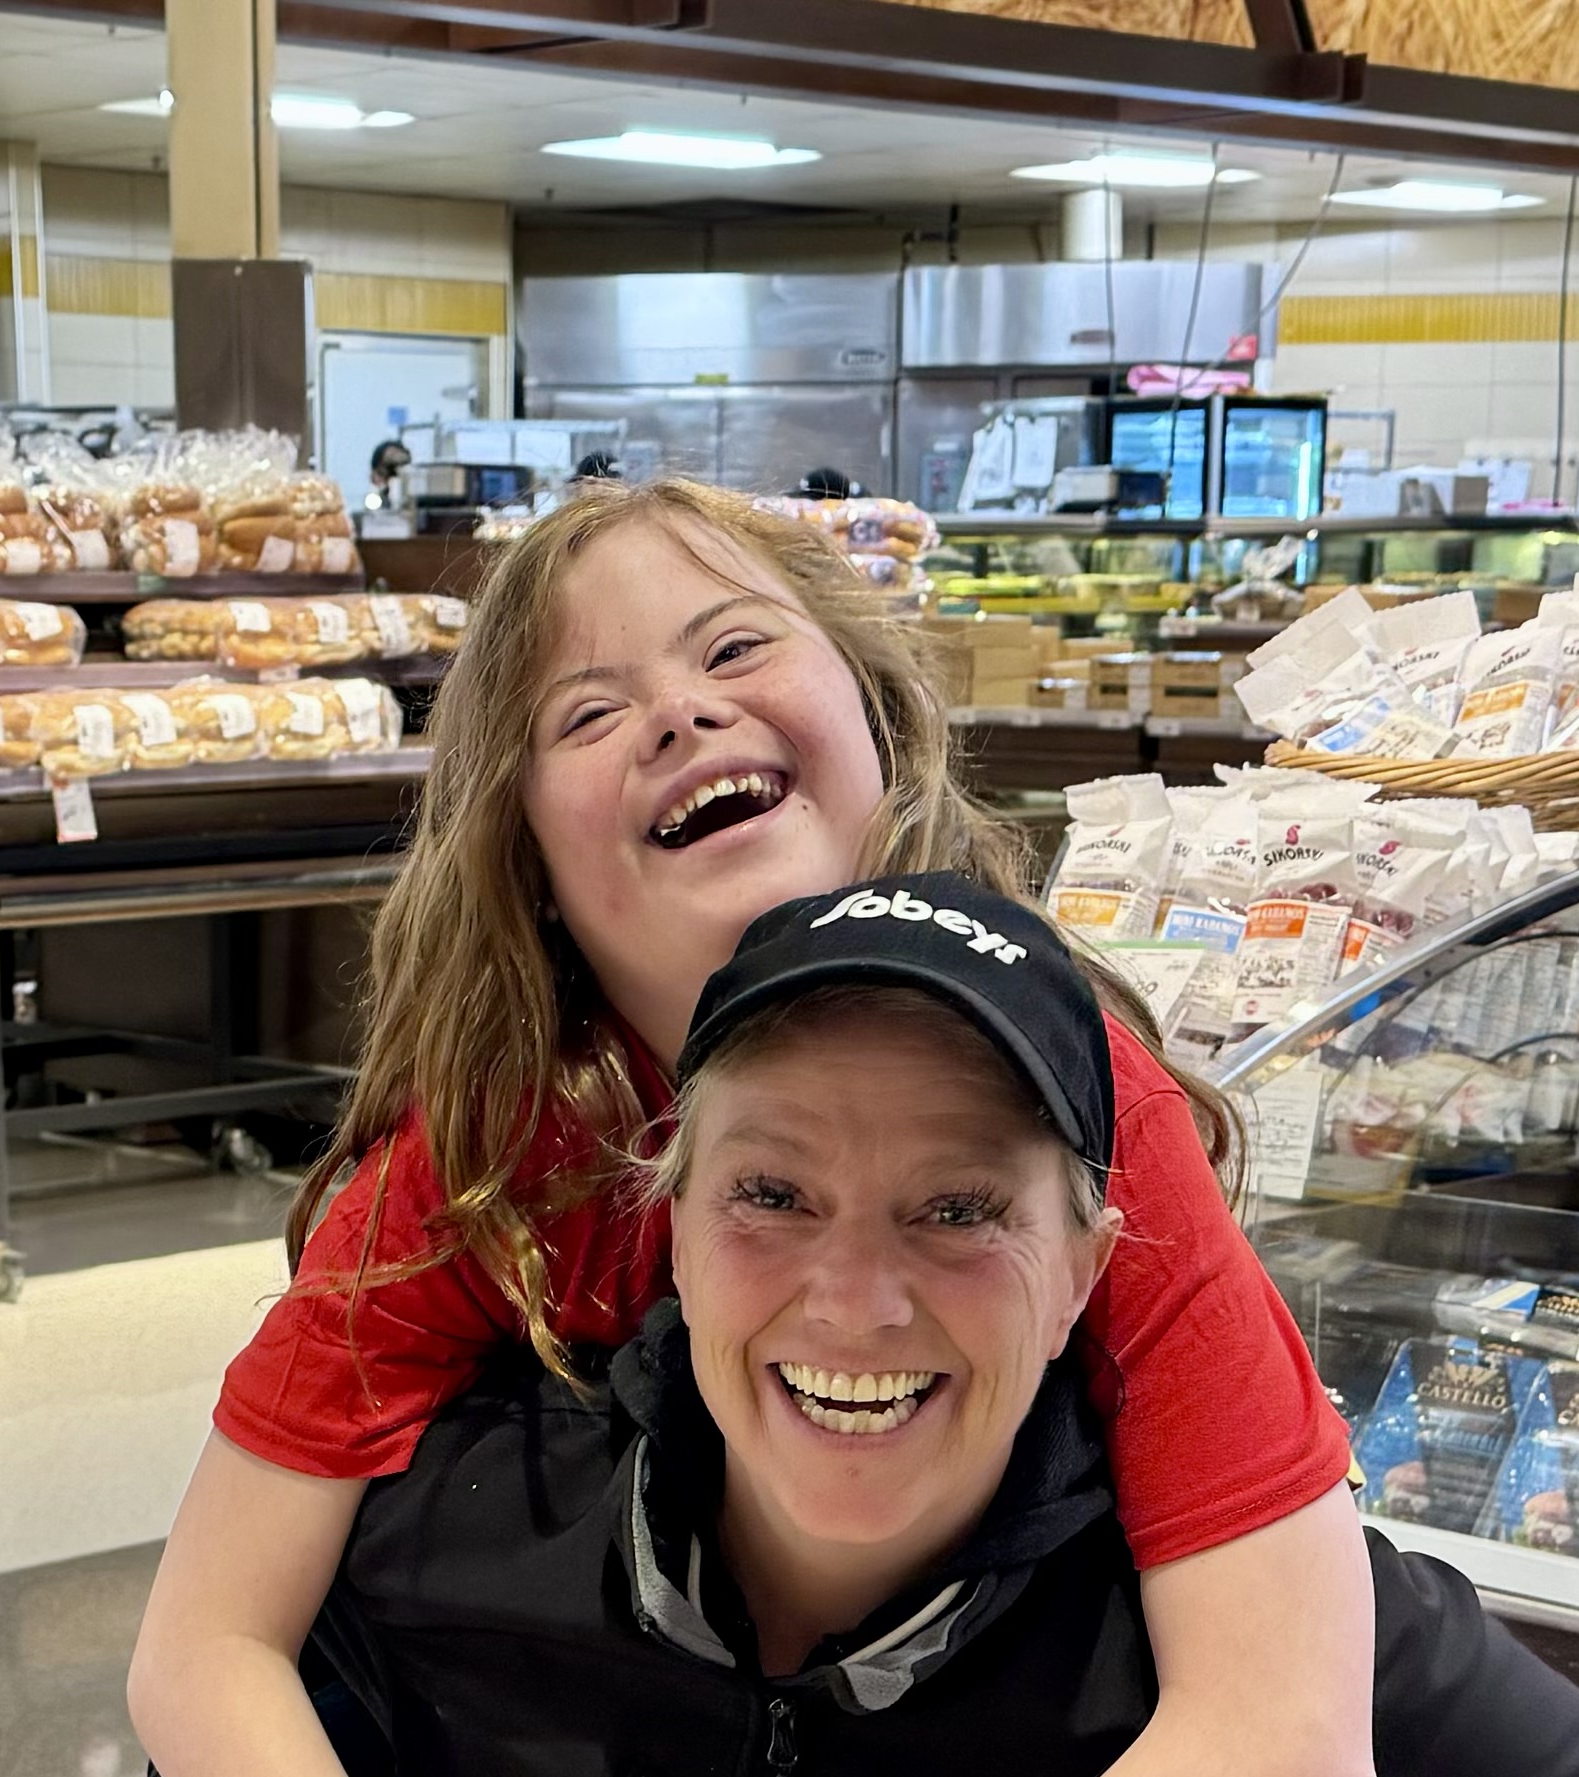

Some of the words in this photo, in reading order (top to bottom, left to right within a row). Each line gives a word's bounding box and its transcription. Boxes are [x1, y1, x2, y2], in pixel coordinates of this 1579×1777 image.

[1262, 846, 1324, 867] SIKORSKI
[809, 888, 1028, 966] Sobeys
[1417, 1381, 1507, 1410] CASTELLO
